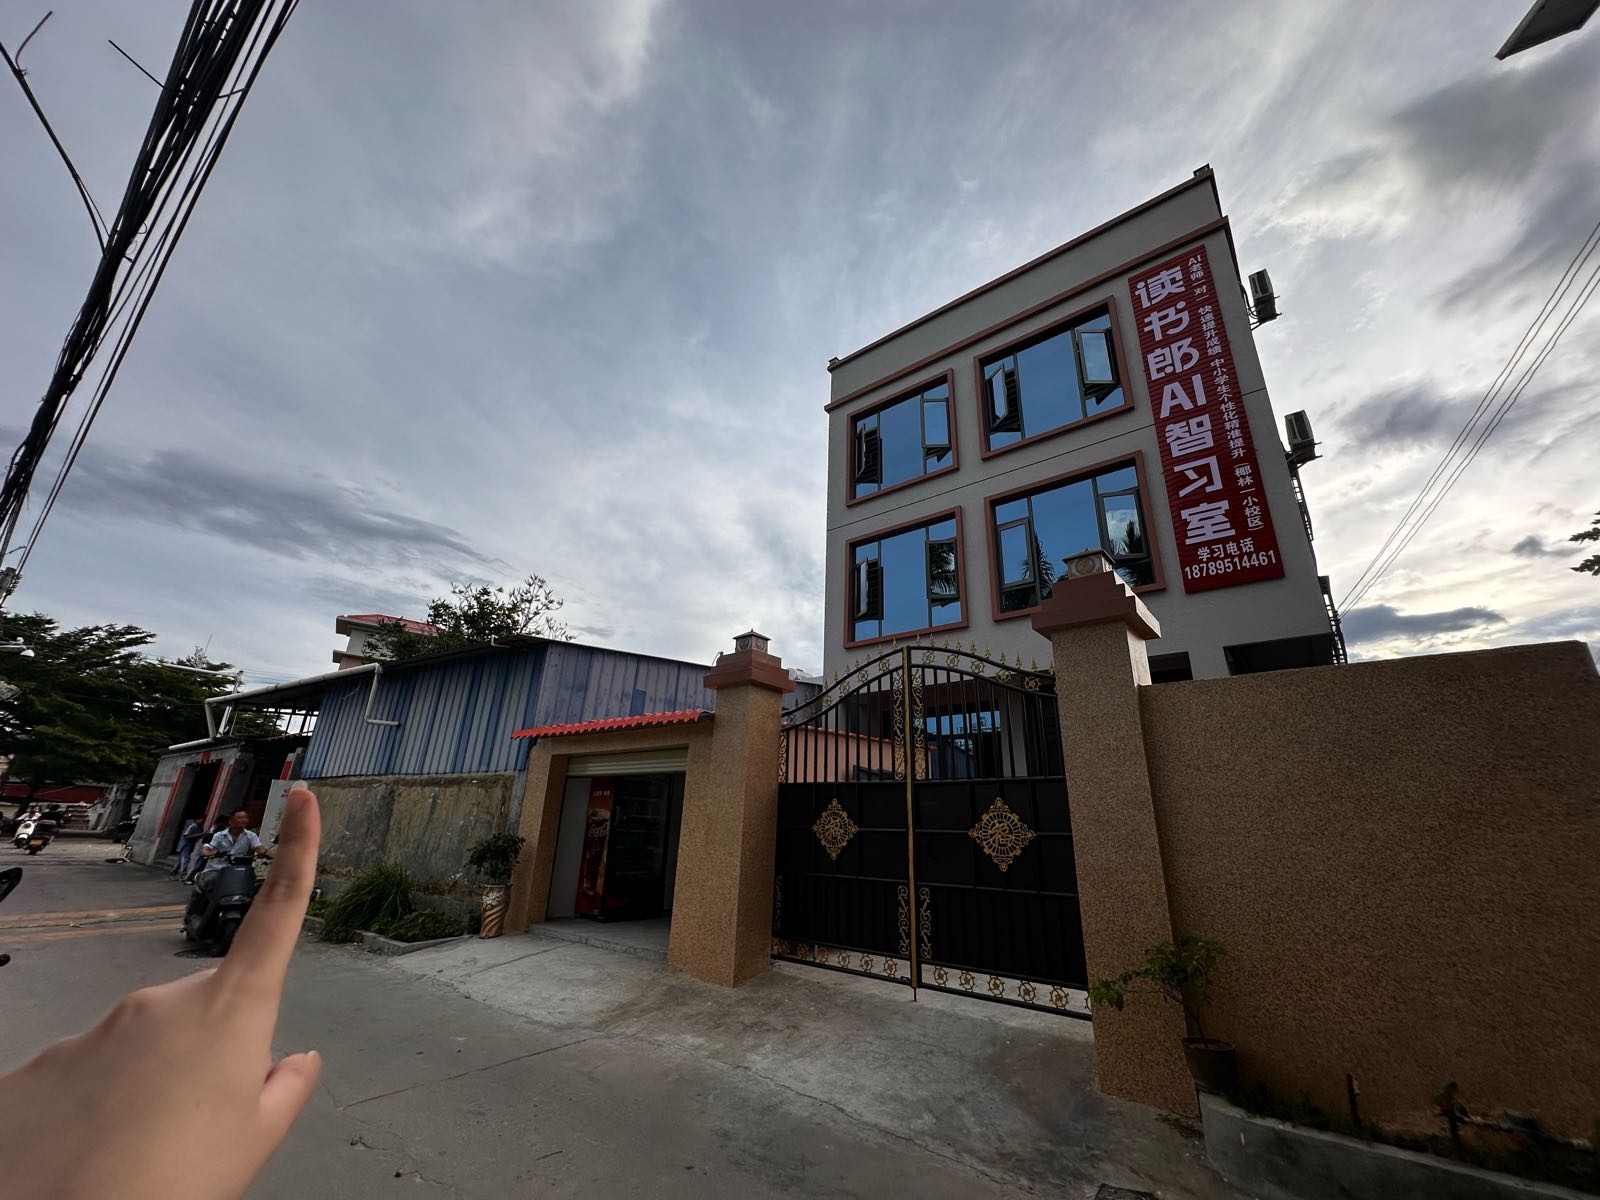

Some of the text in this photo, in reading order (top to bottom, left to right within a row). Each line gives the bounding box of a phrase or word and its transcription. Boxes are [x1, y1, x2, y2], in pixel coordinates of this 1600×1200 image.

[1135, 265, 1236, 545] 读书郎AI智习室
[1197, 537, 1255, 562] 学习电话
[1184, 550, 1277, 580] 18789514461
